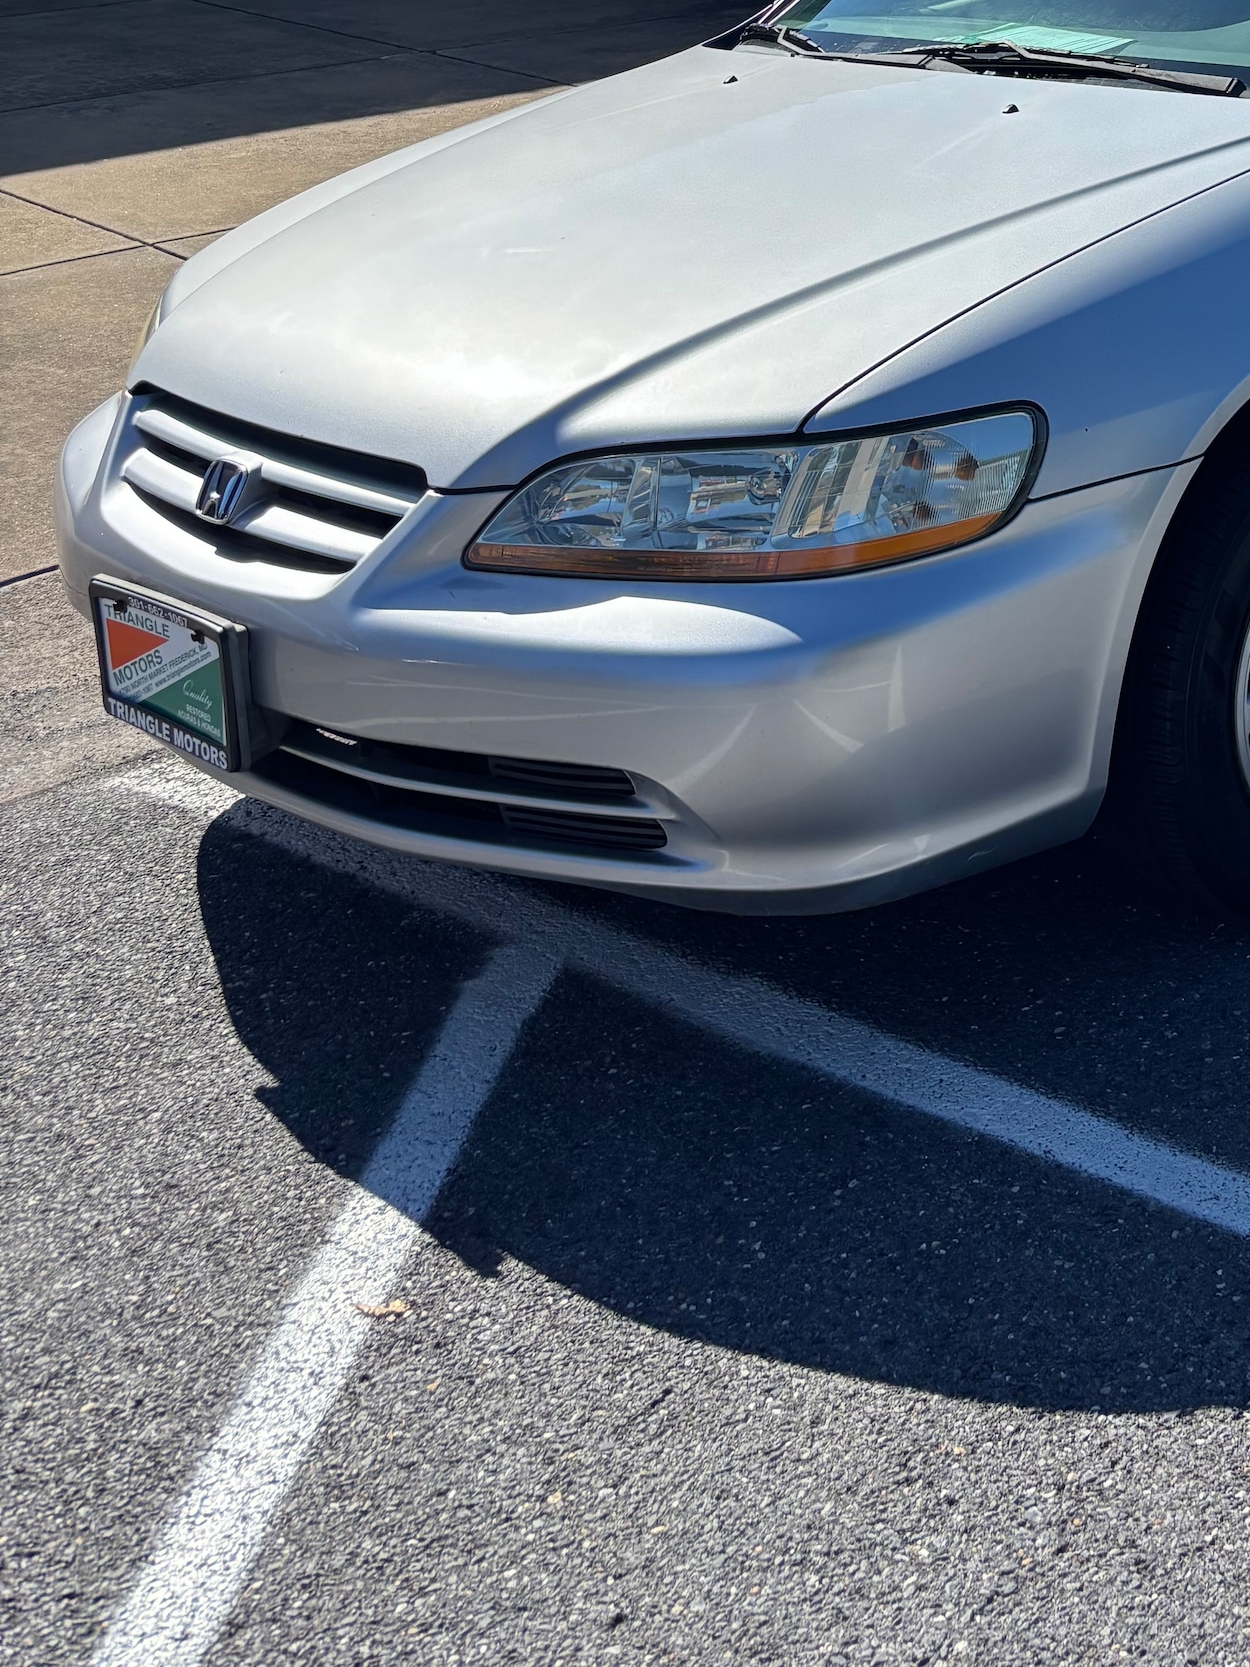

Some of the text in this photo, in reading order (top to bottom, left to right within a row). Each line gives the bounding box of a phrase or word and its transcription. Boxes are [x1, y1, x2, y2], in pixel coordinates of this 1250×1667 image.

[104, 604, 171, 639] TRIANGLE
[128, 596, 188, 628] 301-662-1067
[112, 649, 163, 686] MOTORS
[131, 676, 149, 691] NORTH
[149, 663, 168, 682] MARKET
[183, 679, 213, 710] Quality
[186, 704, 211, 722] RESTORED
[108, 697, 228, 770] TRIANGLE MOTORS
